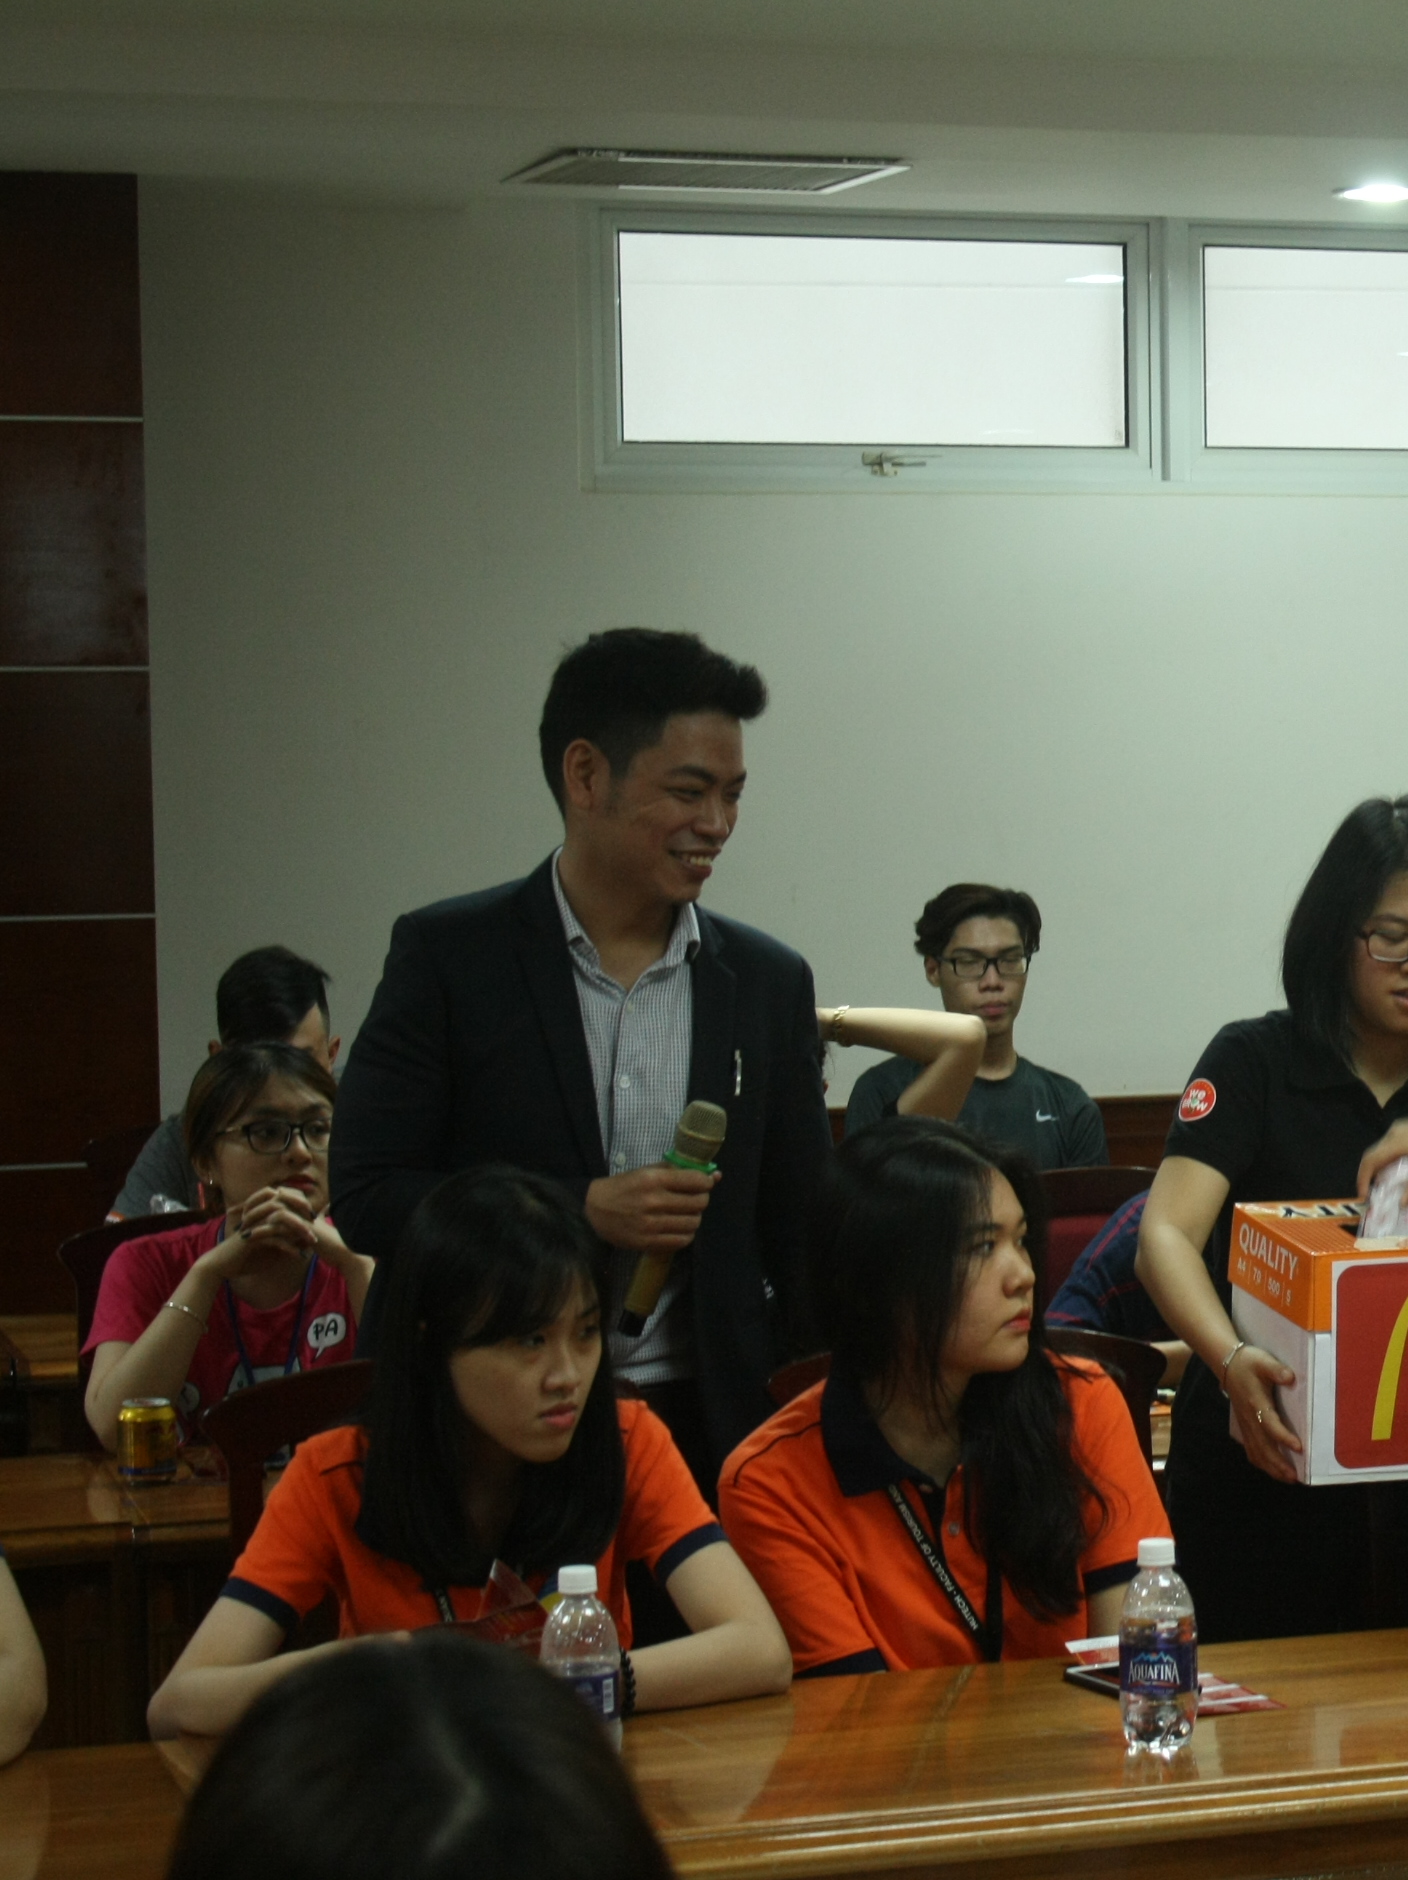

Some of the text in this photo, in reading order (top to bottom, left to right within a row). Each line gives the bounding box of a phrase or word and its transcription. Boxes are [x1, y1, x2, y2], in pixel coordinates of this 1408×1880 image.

[1239, 1222, 1298, 1281] QUALITY
[1237, 1256, 1246, 1272] A4
[1253, 1267, 1262, 1283] 70
[1267, 1276, 1280, 1295] 500
[313, 1318, 339, 1340] PA
[898, 1503, 924, 1543] TOURISM
[920, 1543, 932, 1555] OF
[928, 1554, 955, 1592] FACULTY
[953, 1594, 979, 1631] HUTECH
[1128, 1660, 1180, 1685] AQUAFINA
